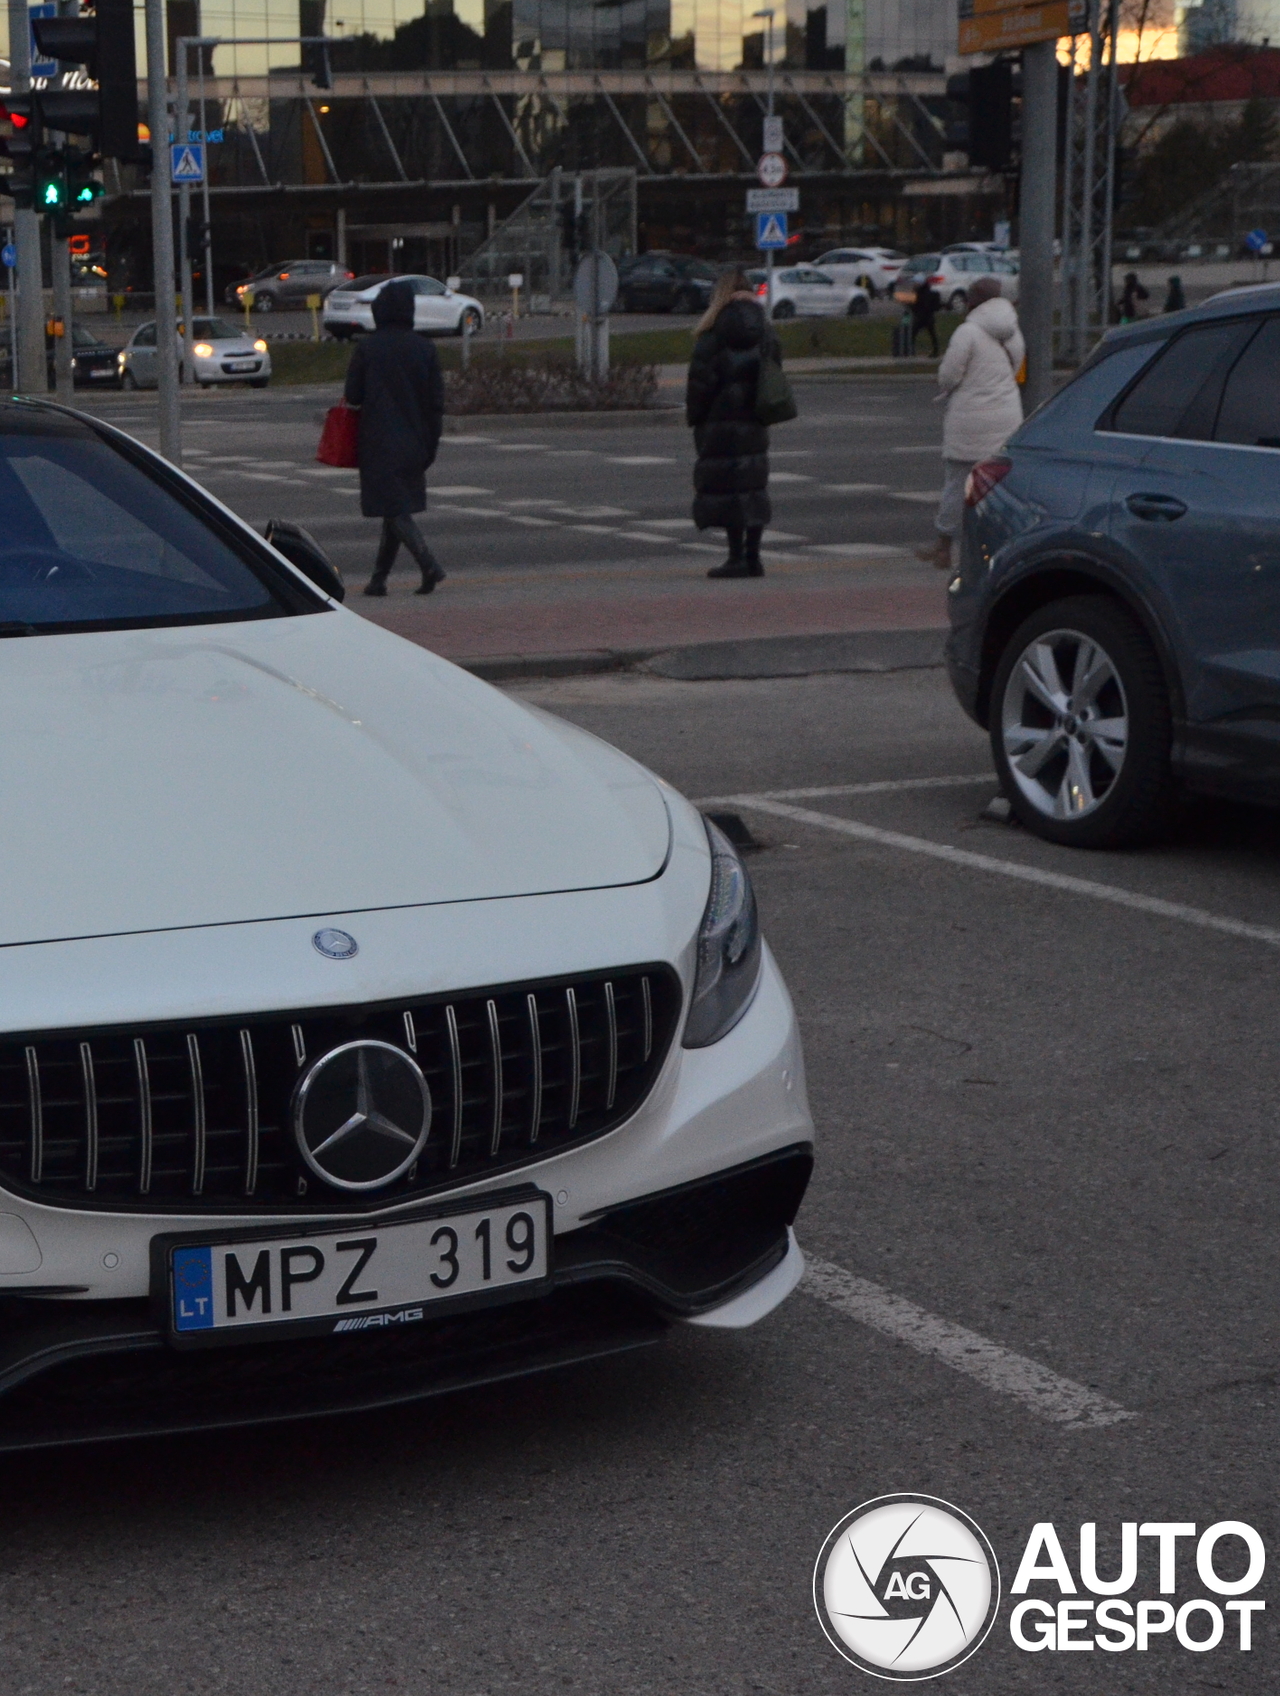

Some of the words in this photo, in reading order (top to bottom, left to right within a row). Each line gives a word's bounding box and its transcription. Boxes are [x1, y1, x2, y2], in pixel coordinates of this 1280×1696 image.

[225, 1237, 379, 1318] MPZ
[429, 1211, 535, 1289] 319
[180, 1296, 208, 1318] LT
[365, 1309, 424, 1328] AMG
